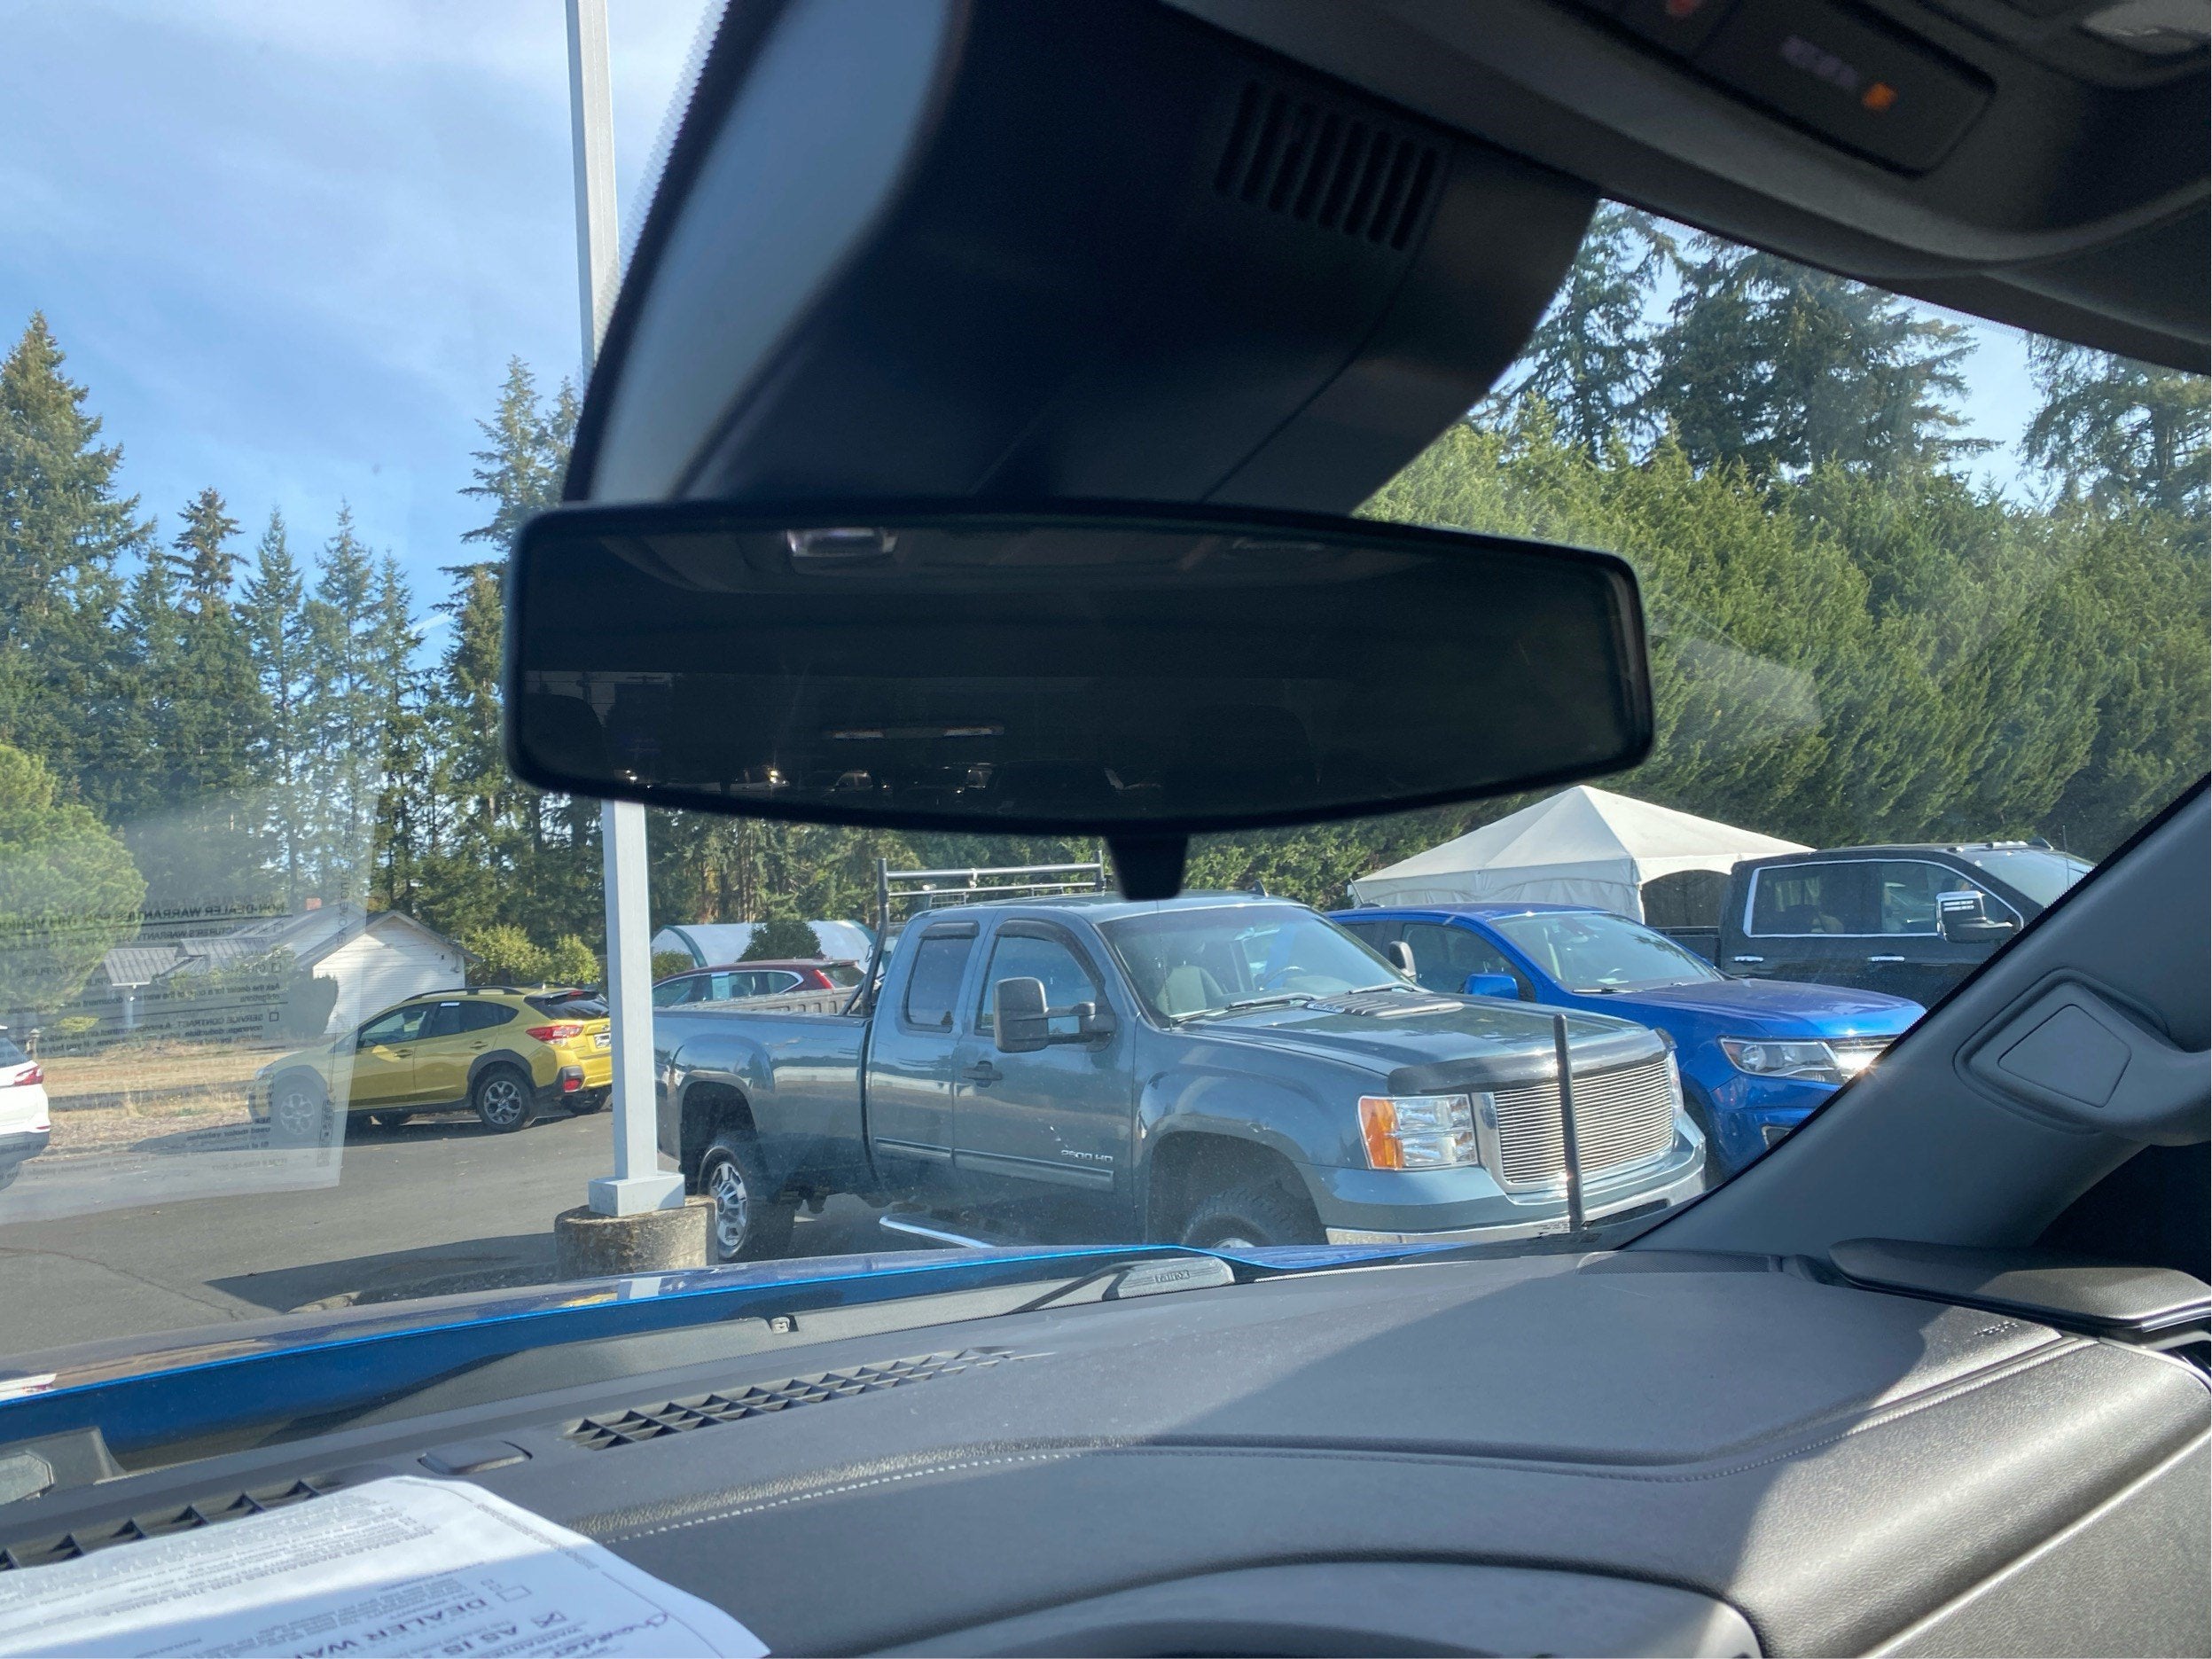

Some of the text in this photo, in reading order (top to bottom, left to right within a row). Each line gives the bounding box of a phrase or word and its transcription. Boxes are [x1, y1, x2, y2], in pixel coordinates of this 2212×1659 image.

[1060, 1149, 1093, 1160] 2500
[363, 1600, 488, 1641] DEALER
[480, 1625, 518, 1643] AS
[442, 1640, 474, 1655] IS
